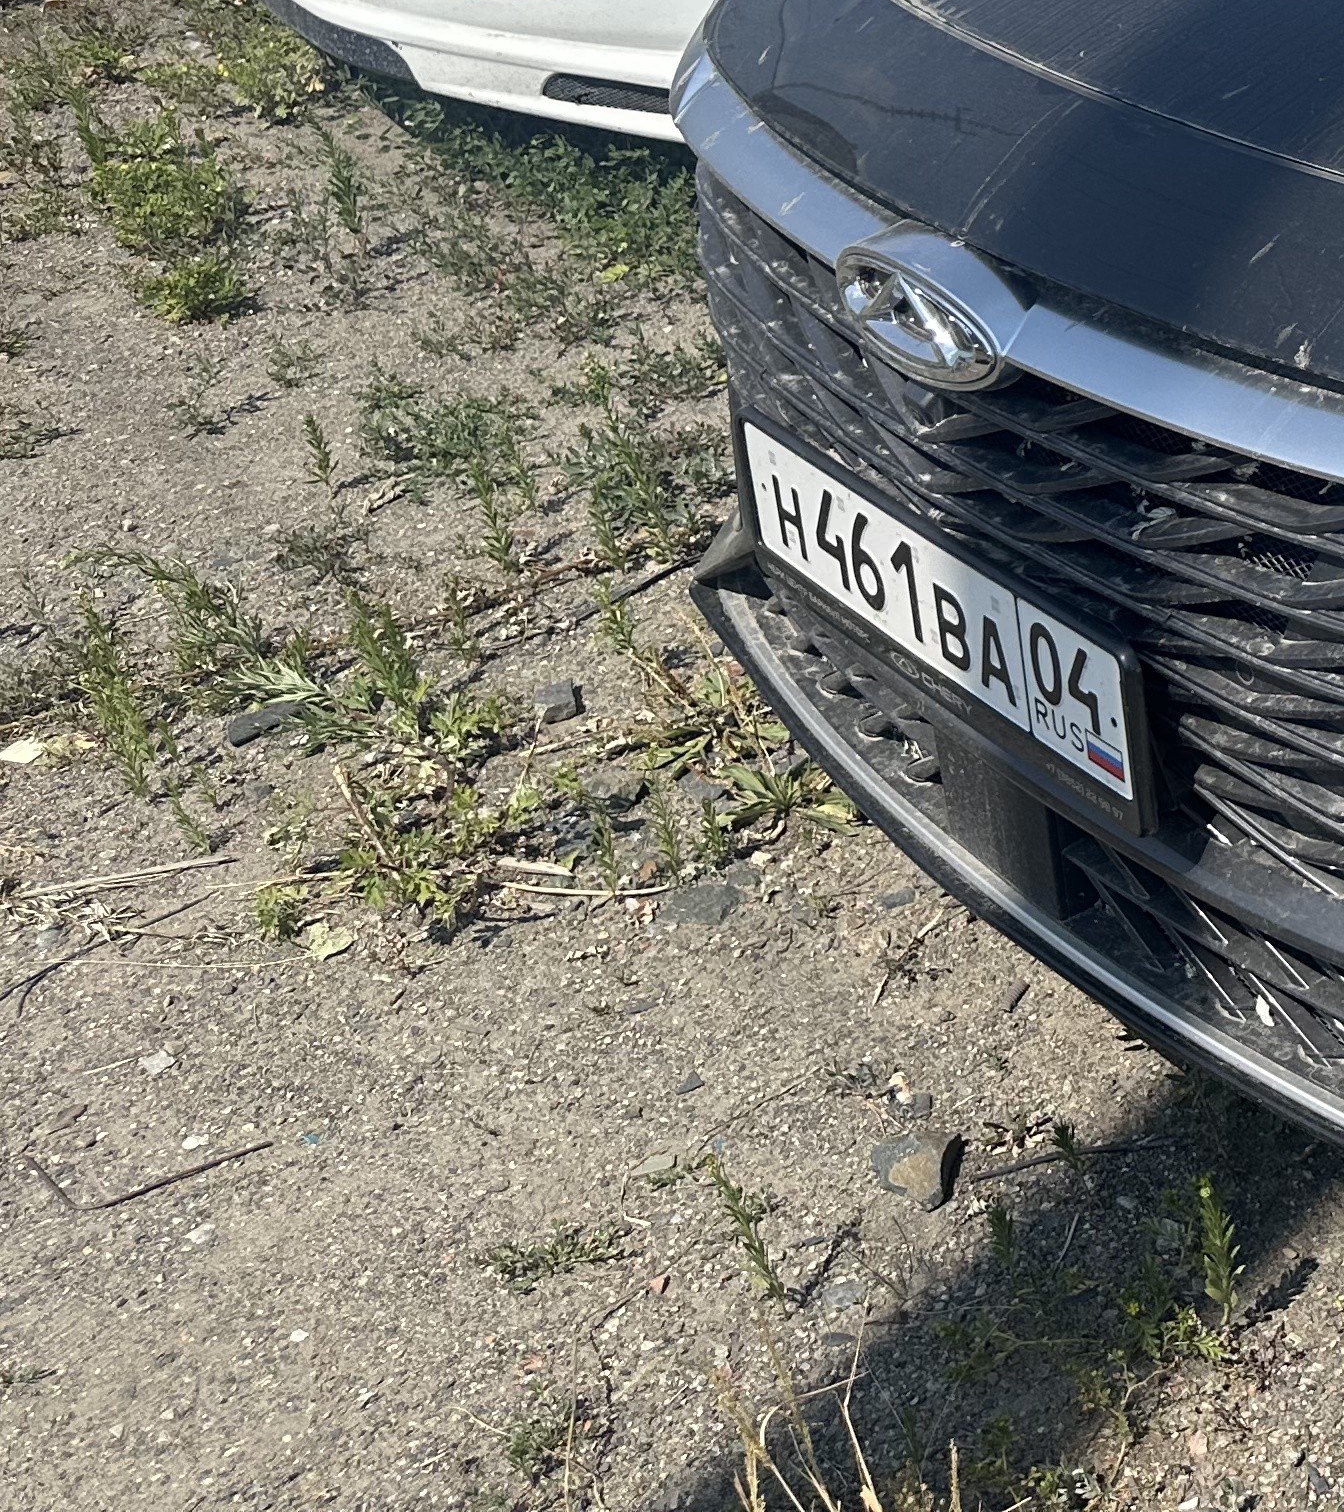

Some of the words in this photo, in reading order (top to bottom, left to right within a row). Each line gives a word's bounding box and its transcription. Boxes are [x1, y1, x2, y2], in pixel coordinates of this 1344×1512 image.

[771, 474, 1018, 708] Н461ВА
[1029, 622, 1102, 737] 04
[921, 671, 974, 715] CHERY
[1034, 697, 1085, 753] RUS
